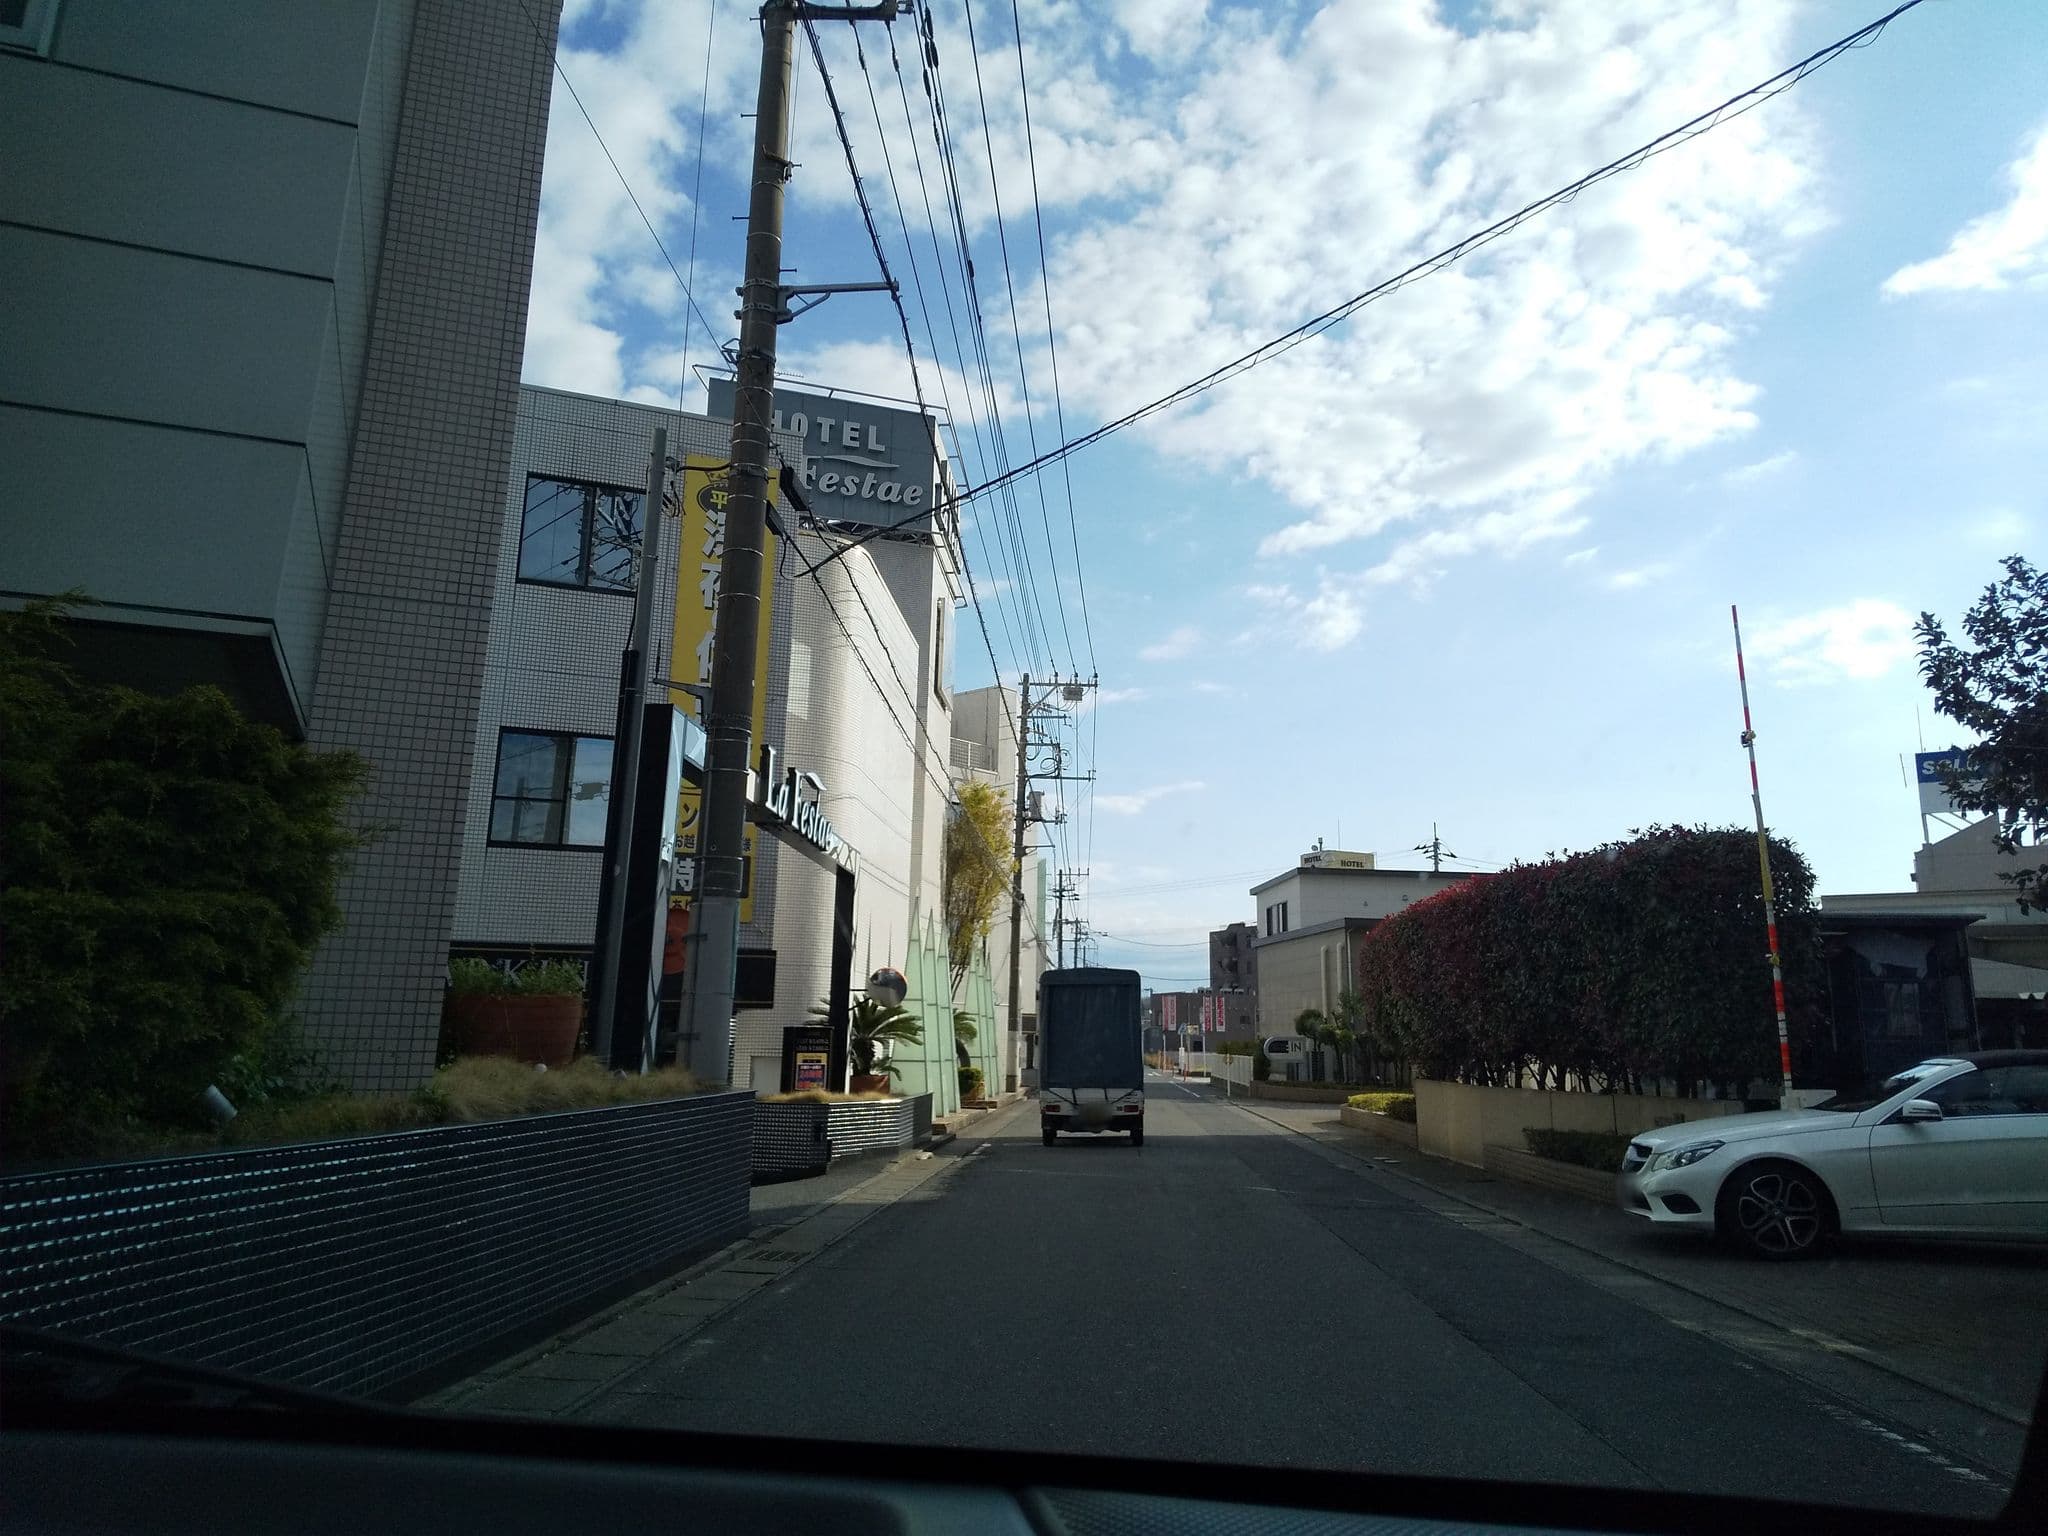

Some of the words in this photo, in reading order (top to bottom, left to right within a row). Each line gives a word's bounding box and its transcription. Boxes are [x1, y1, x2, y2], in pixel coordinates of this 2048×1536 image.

[801, 454, 923, 505] Festae
[1340, 860, 1365, 868] HOTEL
[1290, 1041, 1302, 1052] IN
